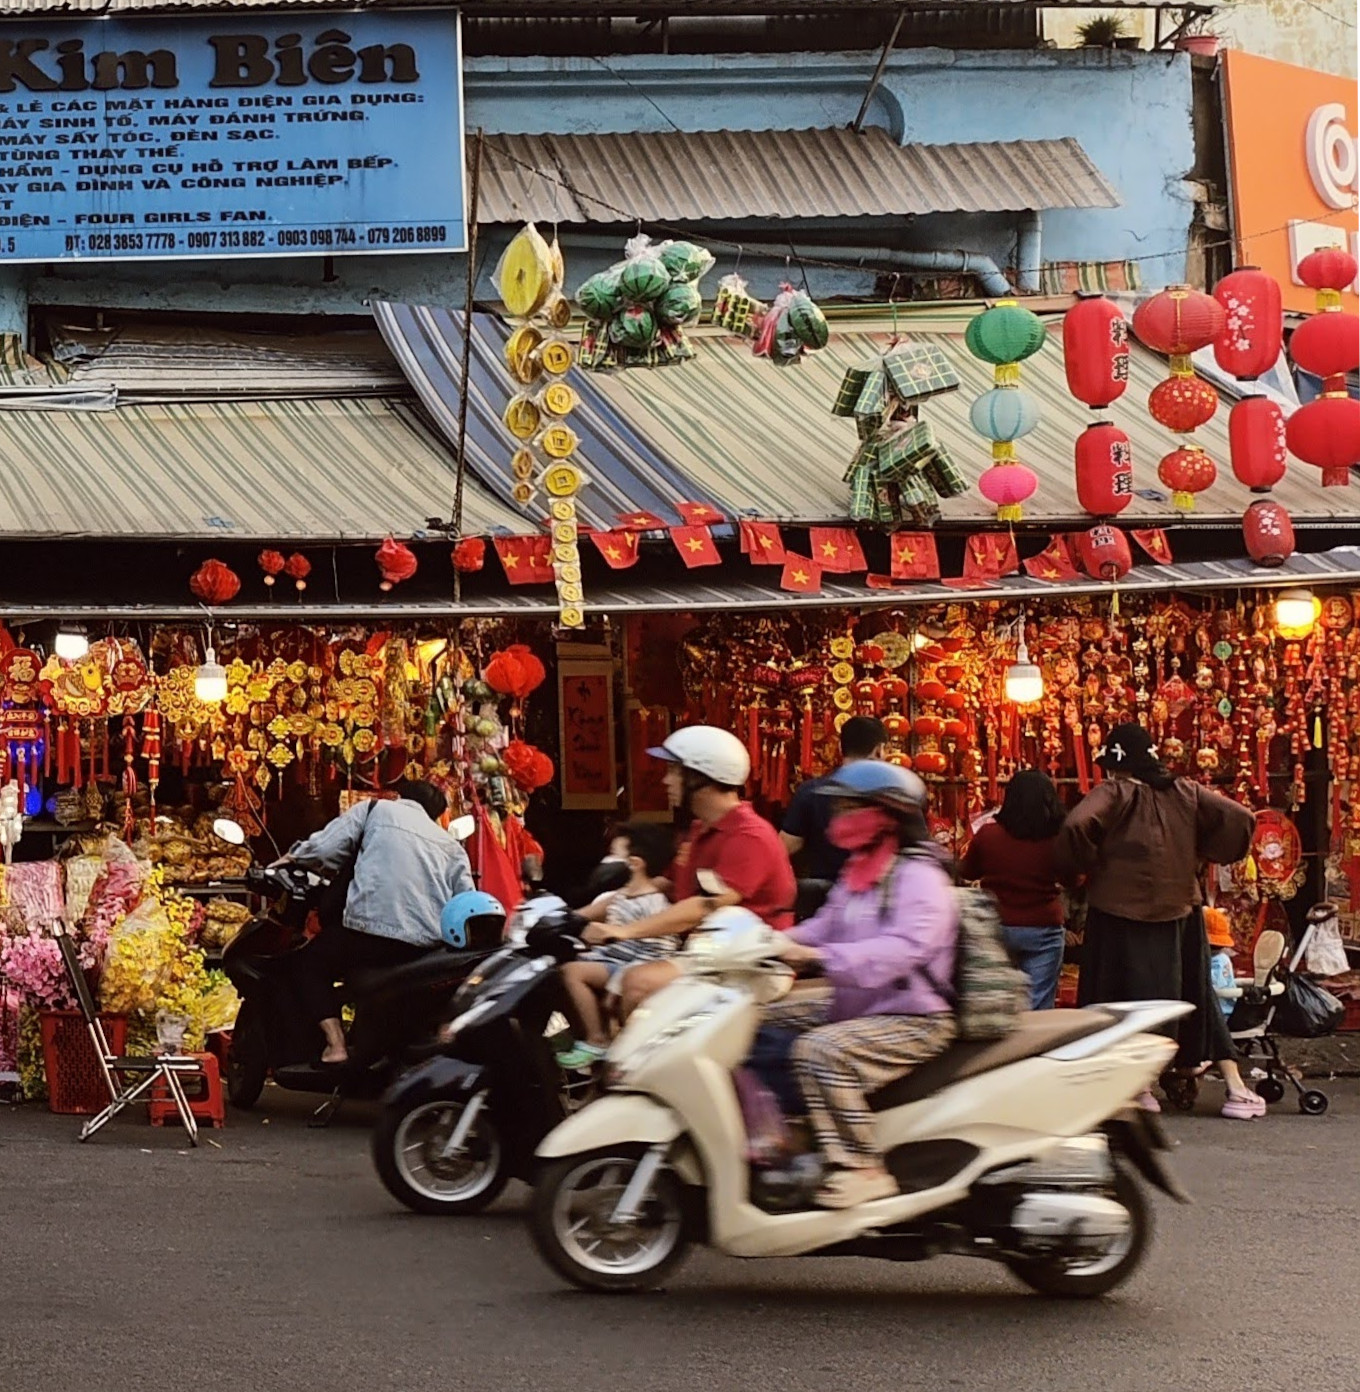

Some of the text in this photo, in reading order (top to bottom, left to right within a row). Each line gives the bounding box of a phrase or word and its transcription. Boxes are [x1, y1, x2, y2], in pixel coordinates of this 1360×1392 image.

[207, 27, 420, 88] Biên
[50, 98, 97, 112] CÁC
[106, 97, 156, 112] MẶT
[163, 95, 229, 109] HÀNG
[237, 93, 292, 109] ĐIỆN
[301, 94, 342, 106] GIA
[350, 92, 424, 107] DỤNG:
[7, 236, 15, 253] 5
